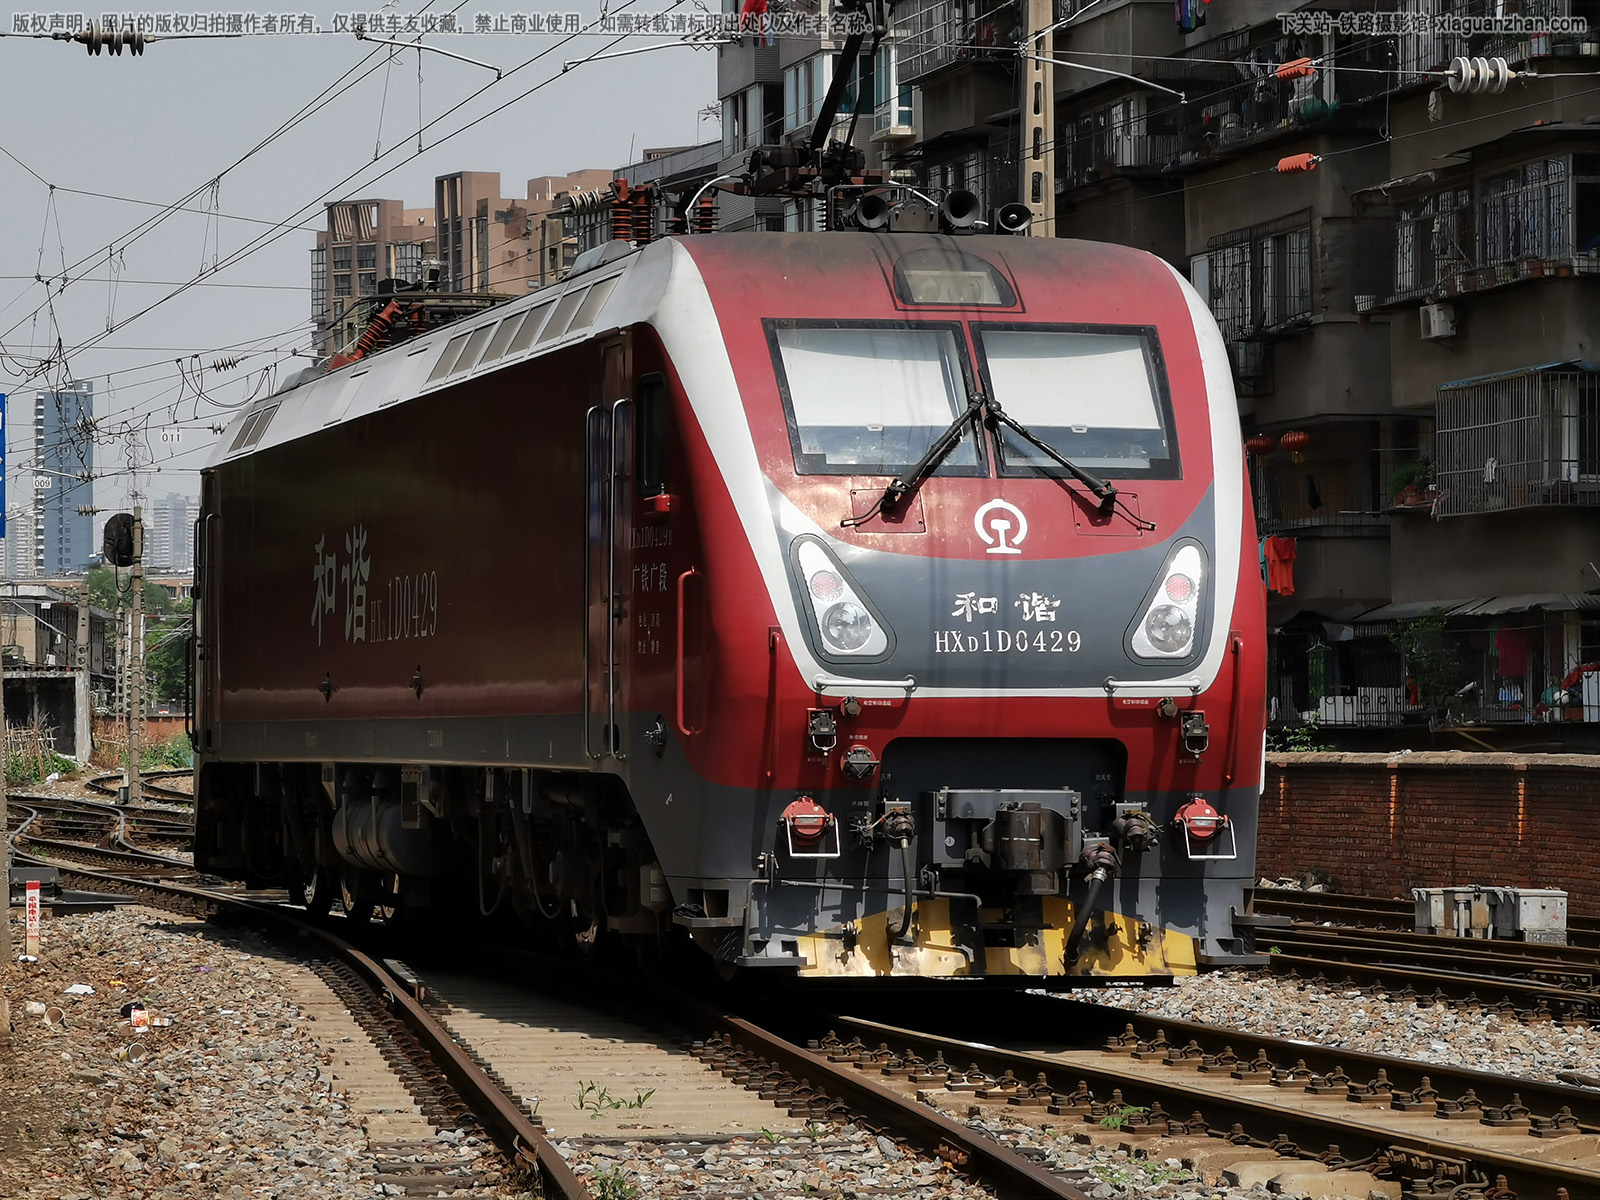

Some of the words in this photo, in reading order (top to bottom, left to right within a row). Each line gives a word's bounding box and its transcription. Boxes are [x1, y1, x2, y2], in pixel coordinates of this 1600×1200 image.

[161, 433, 181, 443] 011
[34, 478, 51, 488] 009
[311, 522, 372, 648] 和谐
[951, 591, 1062, 623] 和谐
[934, 629, 1082, 653] HXD1D0429
